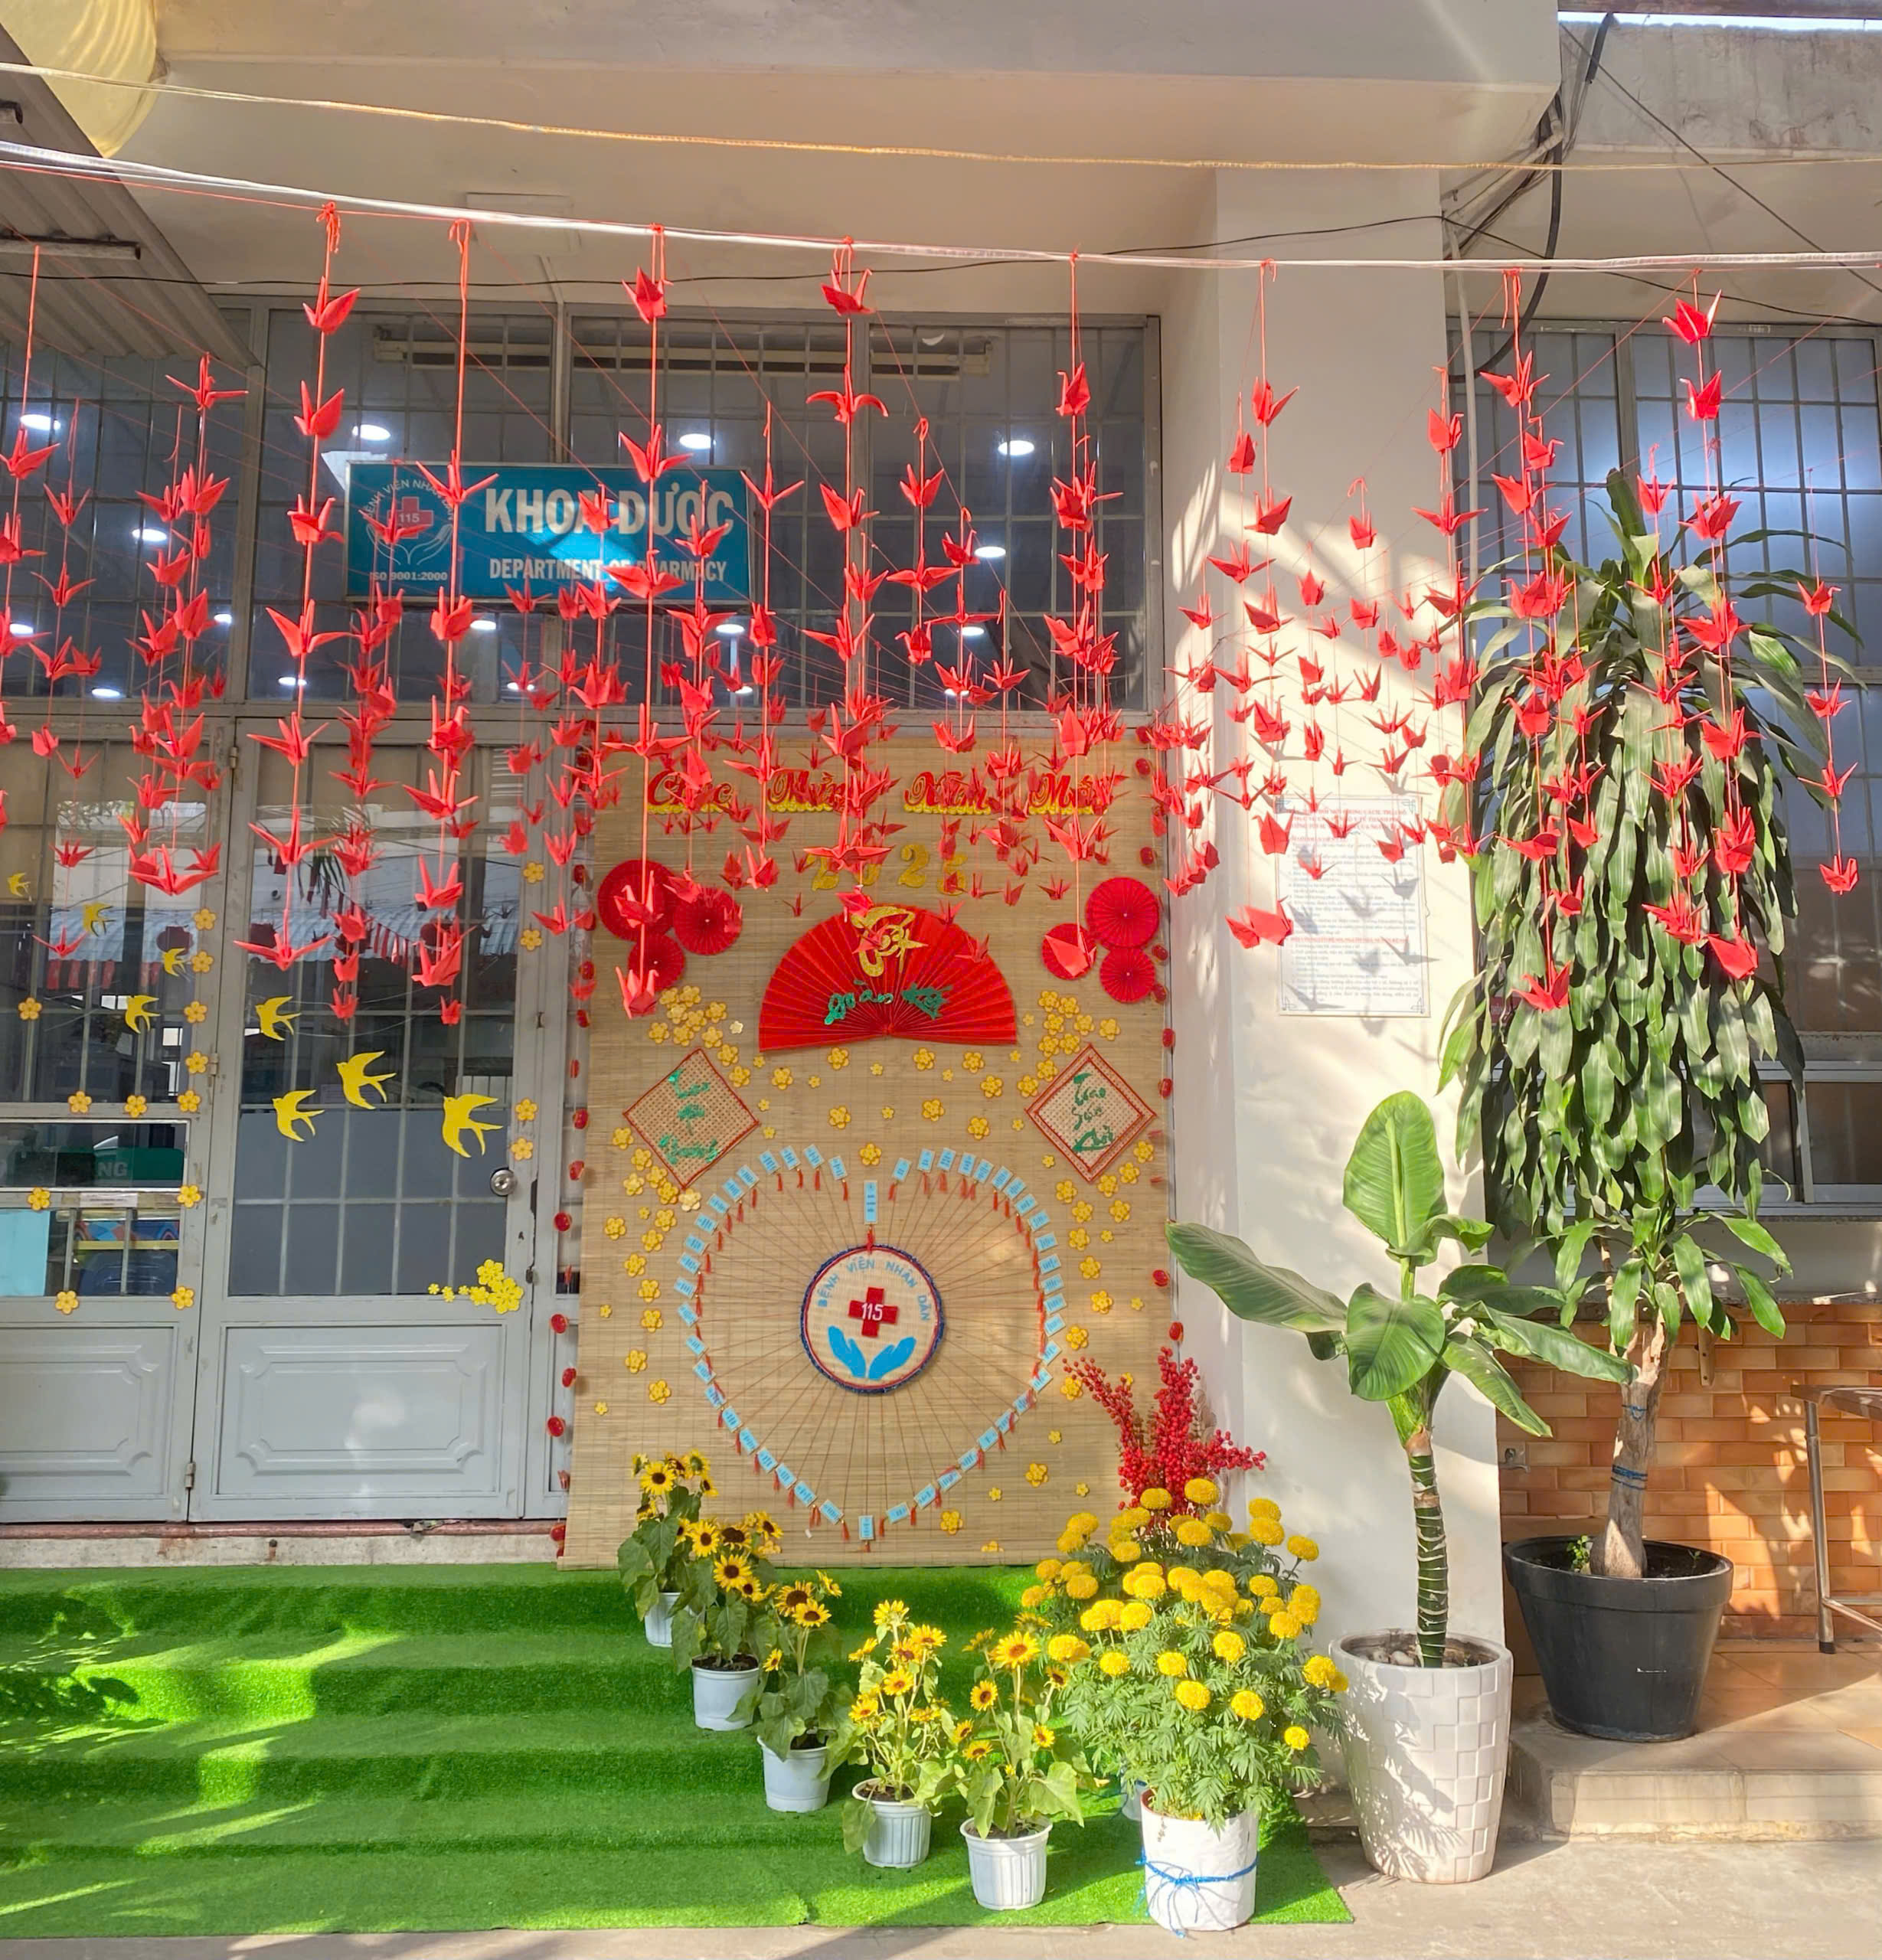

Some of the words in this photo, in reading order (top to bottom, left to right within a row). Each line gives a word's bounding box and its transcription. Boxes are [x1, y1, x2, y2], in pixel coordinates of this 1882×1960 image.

[399, 513, 420, 522] 115
[389, 572, 448, 581] 9001:2000
[489, 558, 603, 580] DEPARTMENT
[636, 560, 727, 581] ARMCY
[885, 1261, 918, 1288] NHÂN
[861, 1303, 884, 1321] 115
